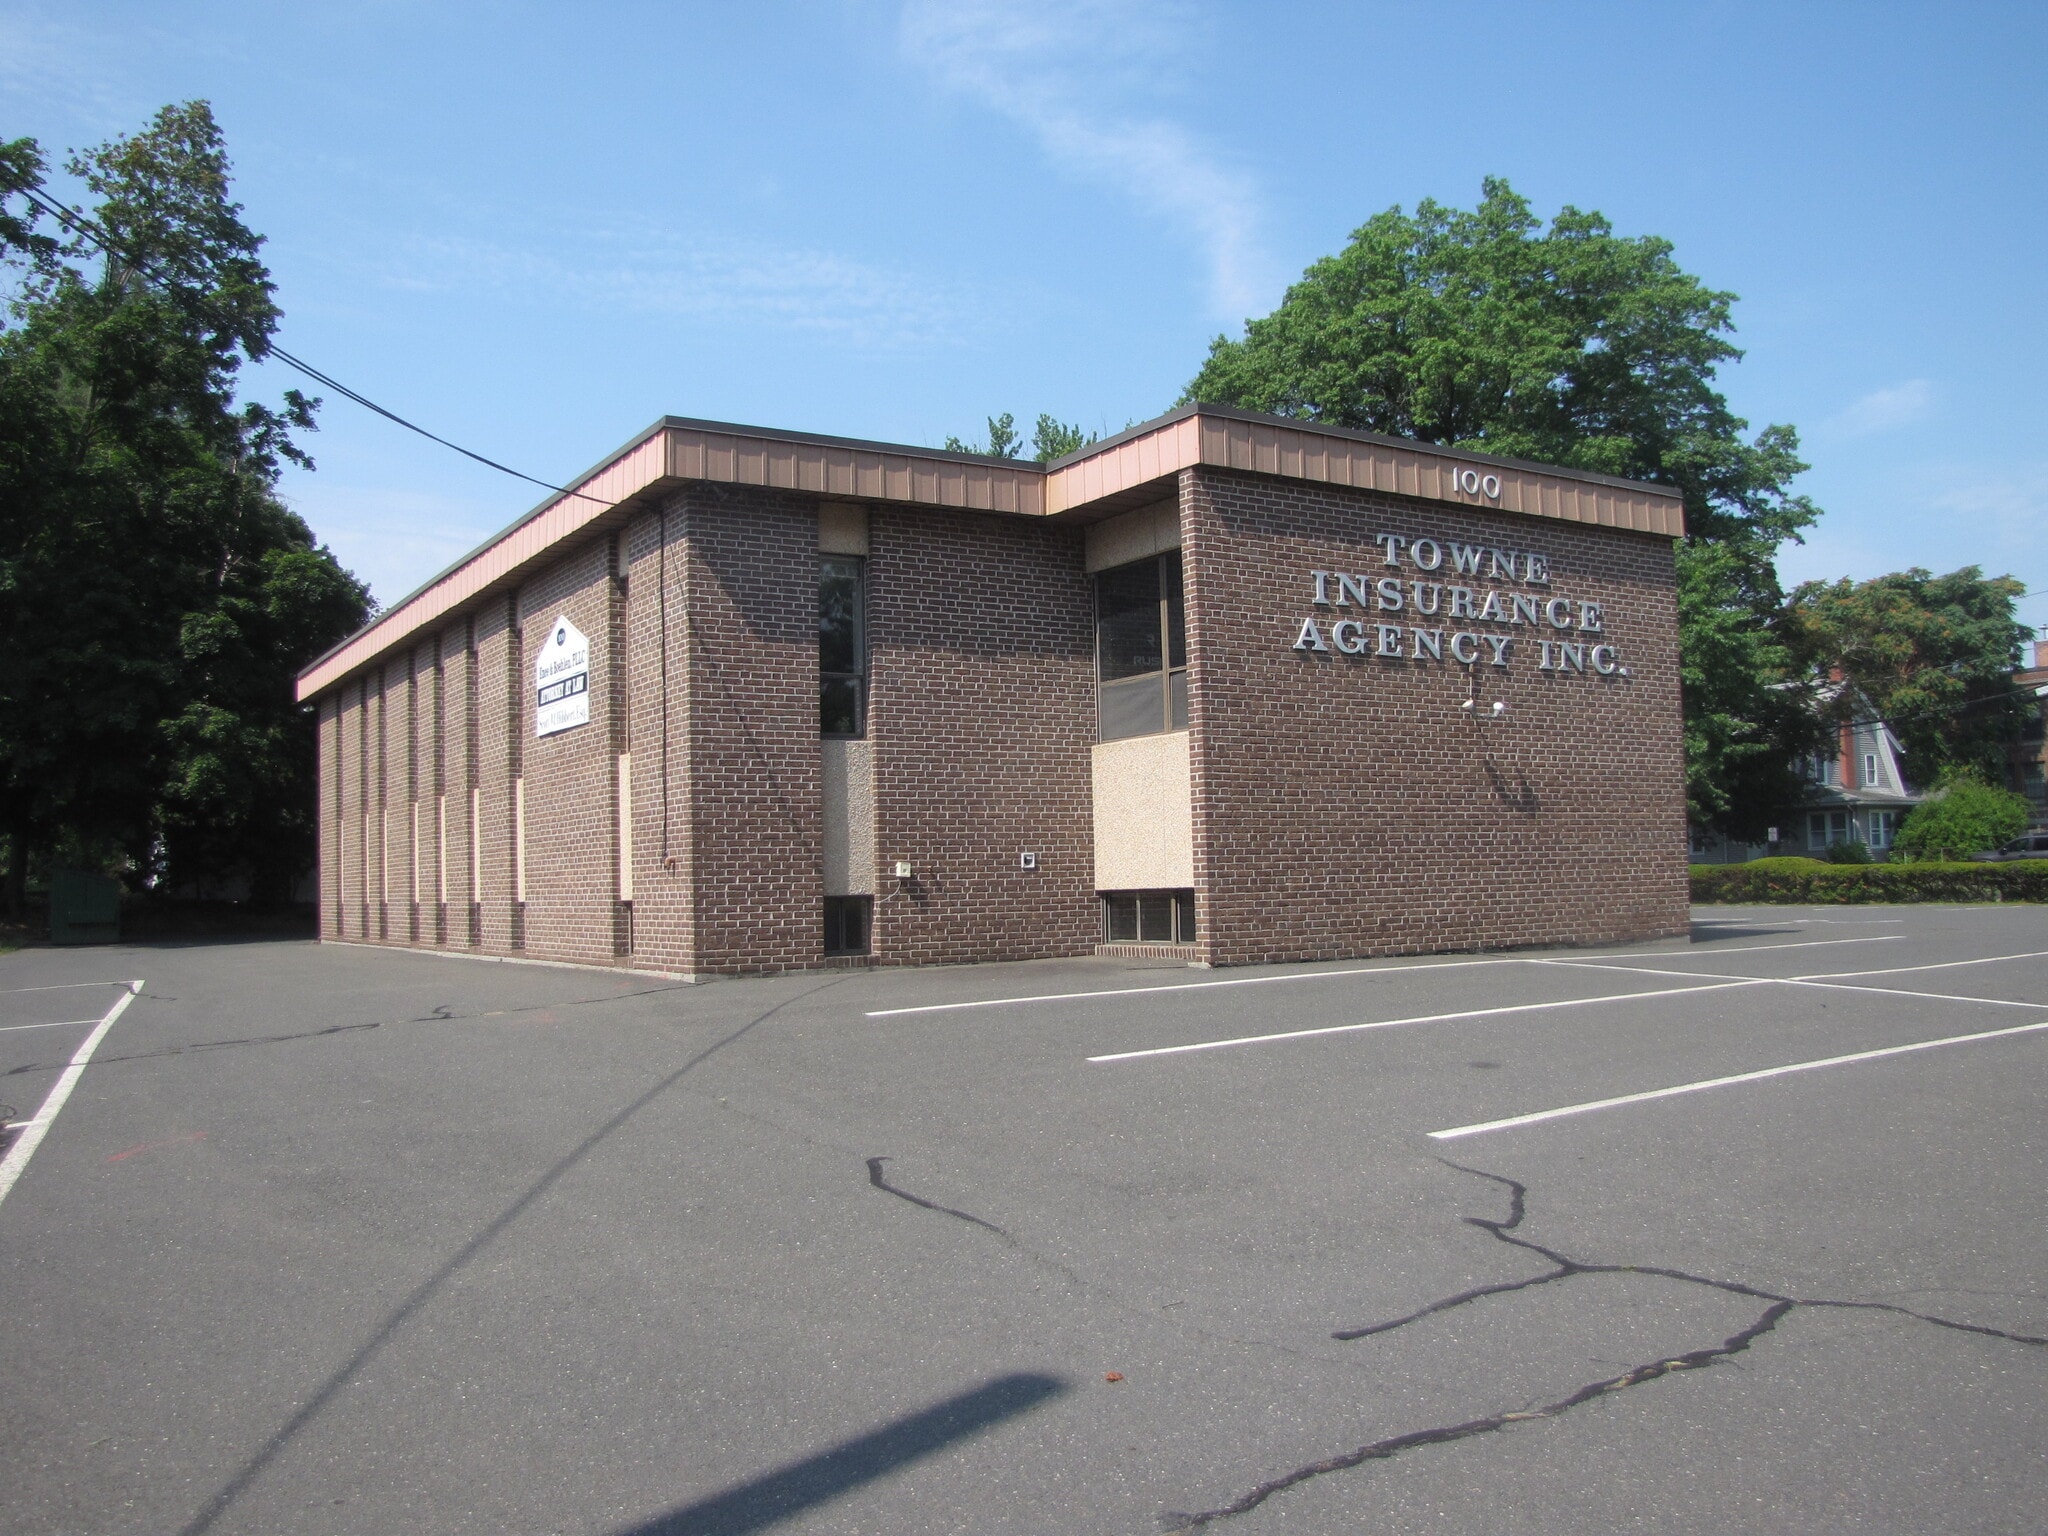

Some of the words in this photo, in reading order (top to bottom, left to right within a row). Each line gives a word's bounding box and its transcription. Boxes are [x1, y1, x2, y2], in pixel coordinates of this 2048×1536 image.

[1452, 467, 1501, 499] 100
[1377, 533, 1549, 585] TOWNE
[1311, 570, 1602, 632] INSURANCE
[1293, 617, 1512, 666] AGENCY
[1537, 640, 1628, 677] INC.
